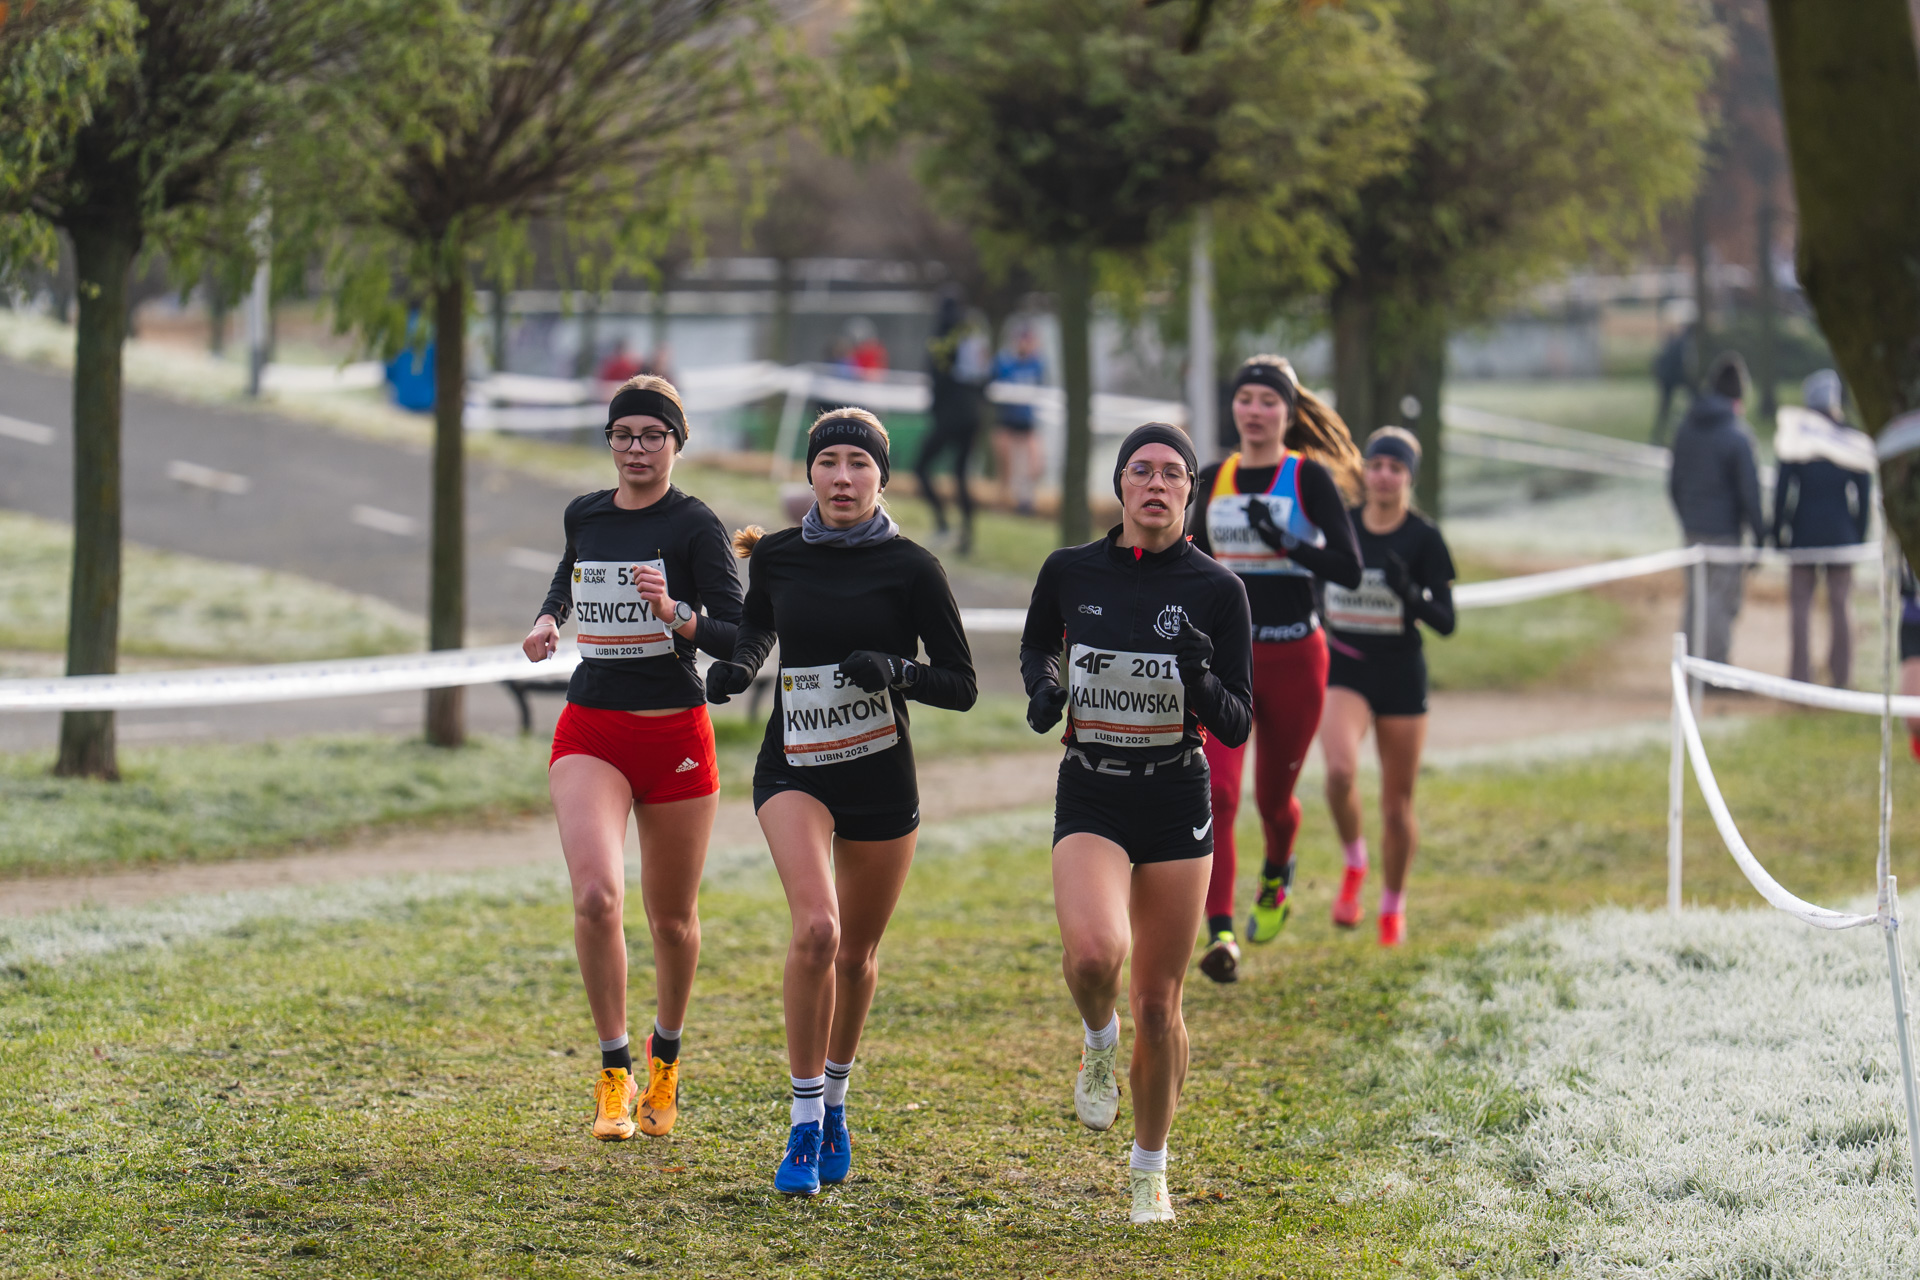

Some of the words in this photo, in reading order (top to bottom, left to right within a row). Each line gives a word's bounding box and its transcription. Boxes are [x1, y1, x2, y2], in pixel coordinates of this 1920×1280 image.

[815, 425, 868, 443] KIPRUN
[583, 568, 607, 576] DOLNY
[583, 575, 606, 585] ŚLĄSK
[1165, 604, 1183, 613] LKS
[1259, 622, 1308, 641] PRO
[595, 647, 619, 656] LUBIN
[620, 646, 644, 655] 2025
[1130, 658, 1174, 680] 201
[794, 673, 820, 683] DOLNY
[796, 682, 821, 691] ŚLĄSK
[1071, 684, 1180, 714] KALINOWSKA
[1095, 732, 1123, 743] LUBIN
[1125, 736, 1151, 744] 2025
[814, 752, 843, 762] LUBIN
[845, 745, 869, 758] 2025
